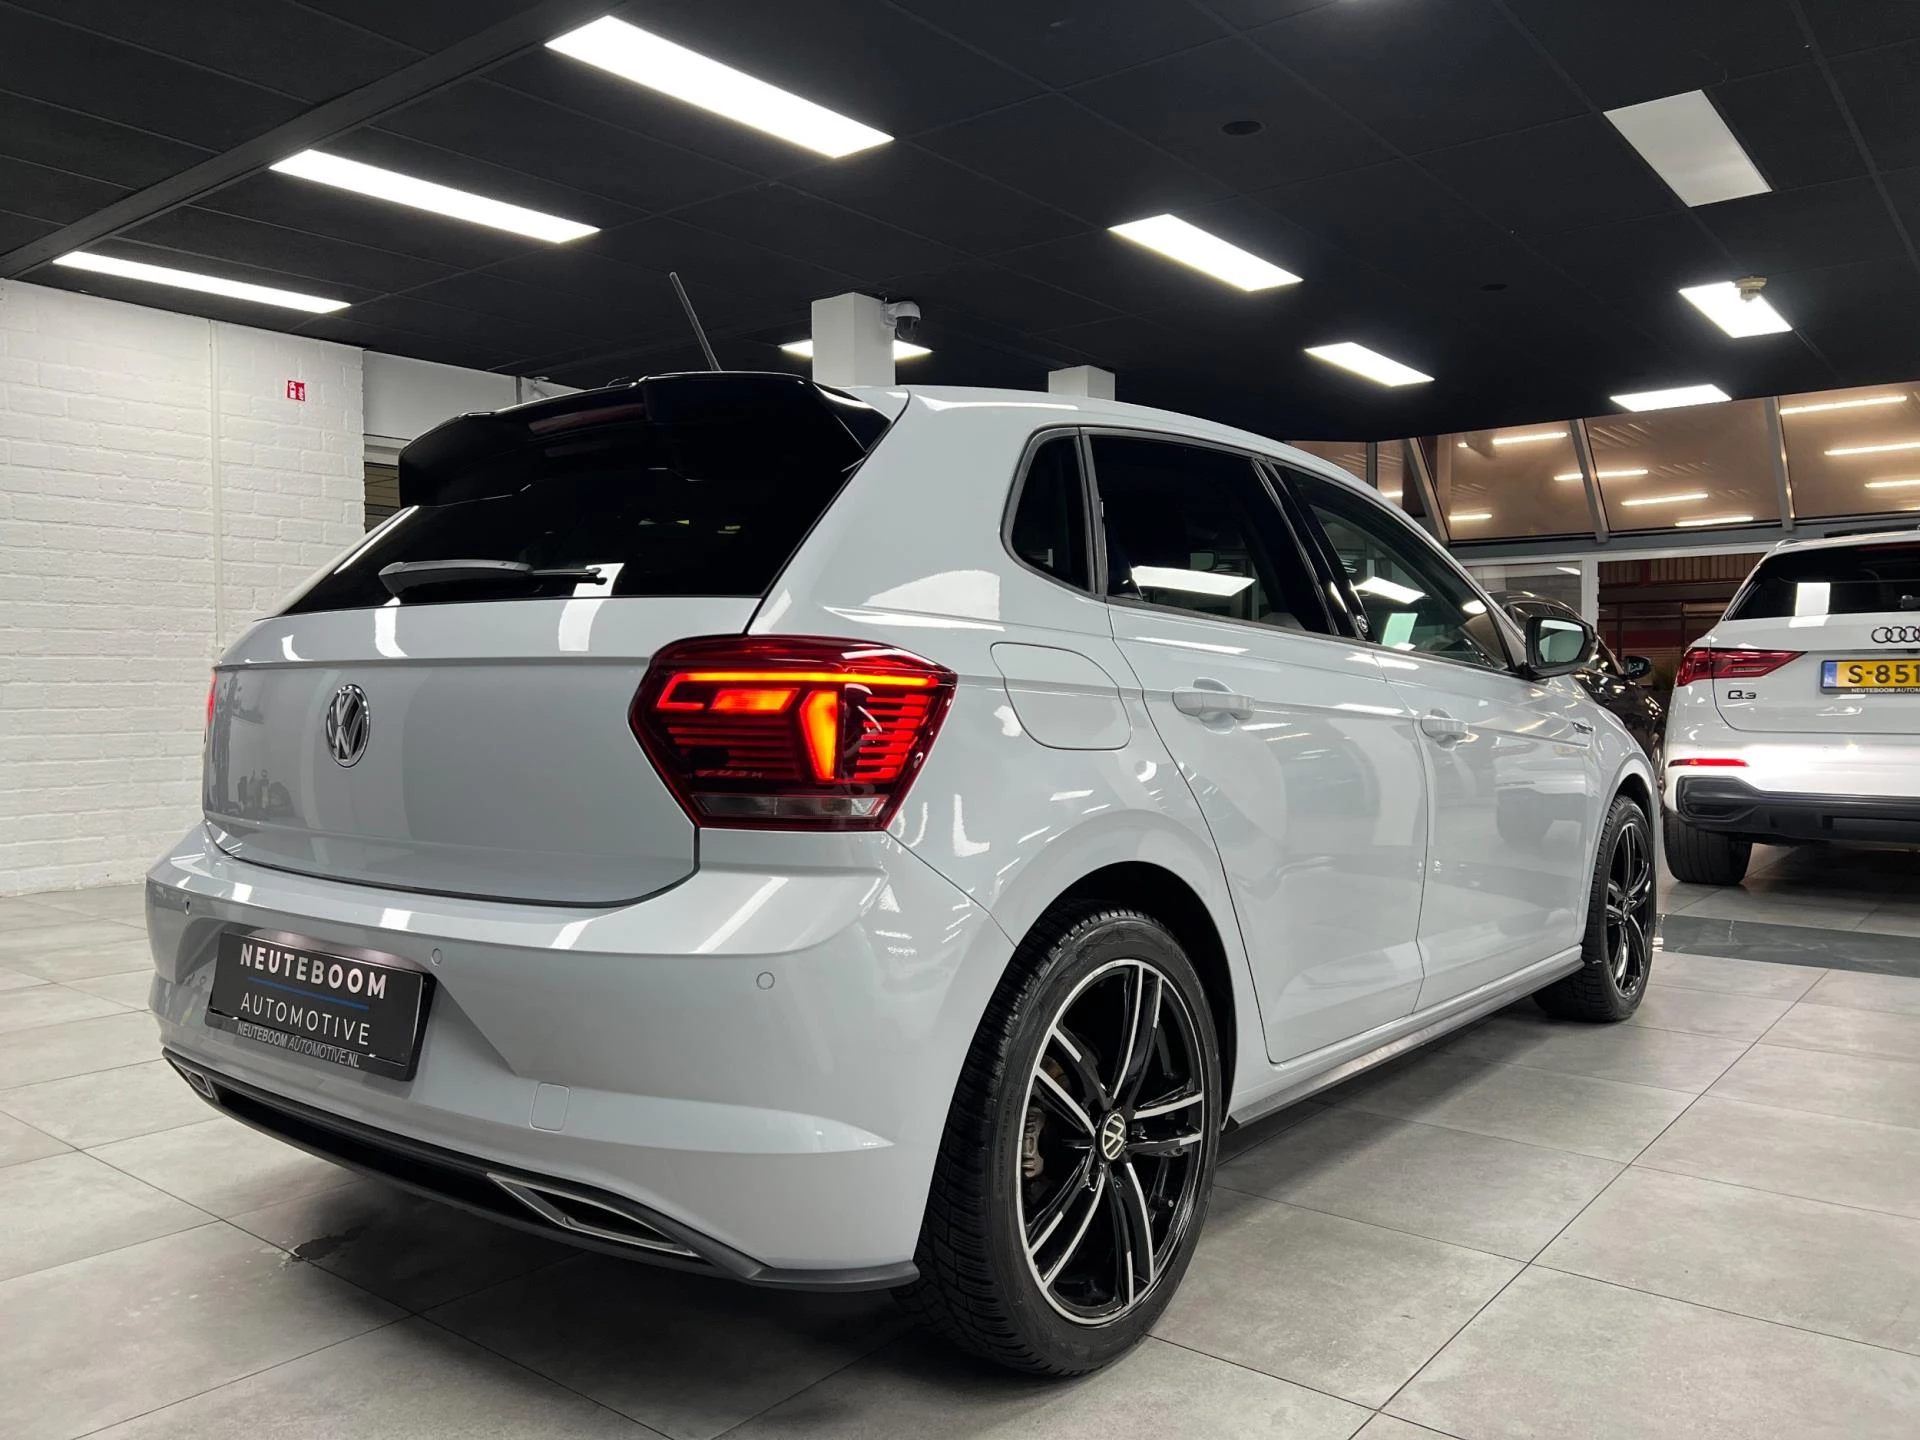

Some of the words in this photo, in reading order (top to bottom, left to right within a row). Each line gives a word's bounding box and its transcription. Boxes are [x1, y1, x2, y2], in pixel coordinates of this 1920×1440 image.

[1727, 689, 1757, 700] Q3
[240, 943, 388, 1000] NEUTEBOOM
[240, 992, 371, 1046] AUTOMOTIVE
[237, 1023, 288, 1046] NEUTEBOOM
[288, 1034, 360, 1068] AUTOMOTIVE.NL
